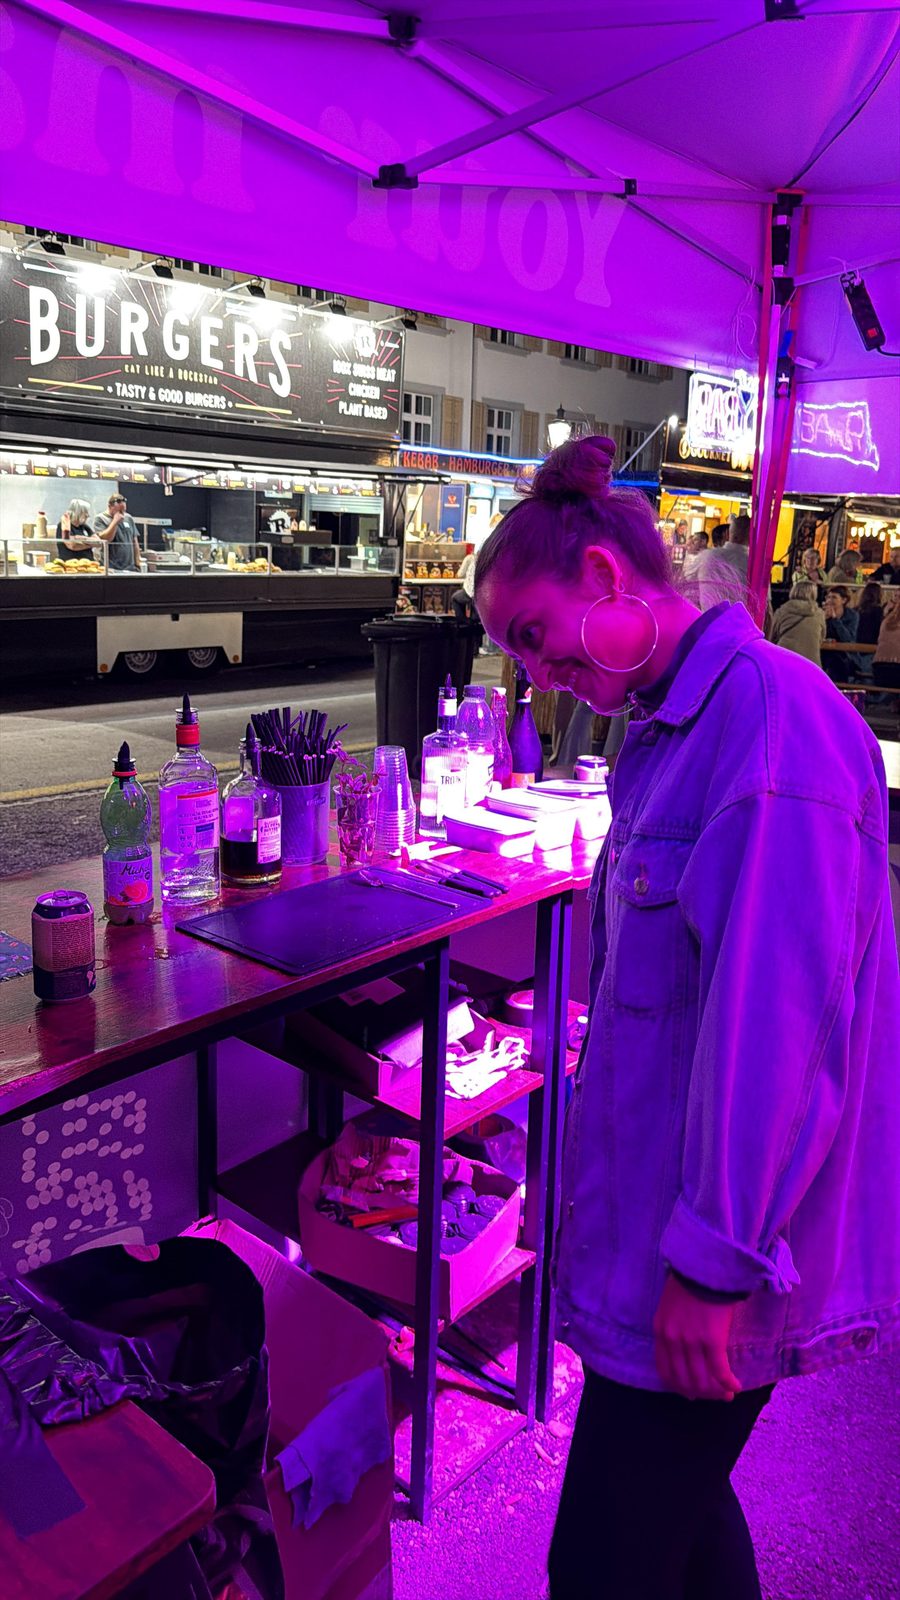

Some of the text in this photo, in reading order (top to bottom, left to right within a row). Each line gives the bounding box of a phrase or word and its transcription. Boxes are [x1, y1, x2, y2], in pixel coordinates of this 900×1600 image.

[29, 285, 291, 398] BURGERS
[124, 364, 218, 385] EAT LIKE A ROCKSTAR
[353, 363, 375, 379] SWISS
[377, 367, 396, 383] MEAT
[115, 382, 226, 410] TASTY & GOOD BURGERS
[348, 382, 380, 400] CHICKEN
[338, 401, 388, 420] PLANT BASED
[403, 451, 439, 470] KEBAB
[449, 457, 509, 476] HAMBURGER
